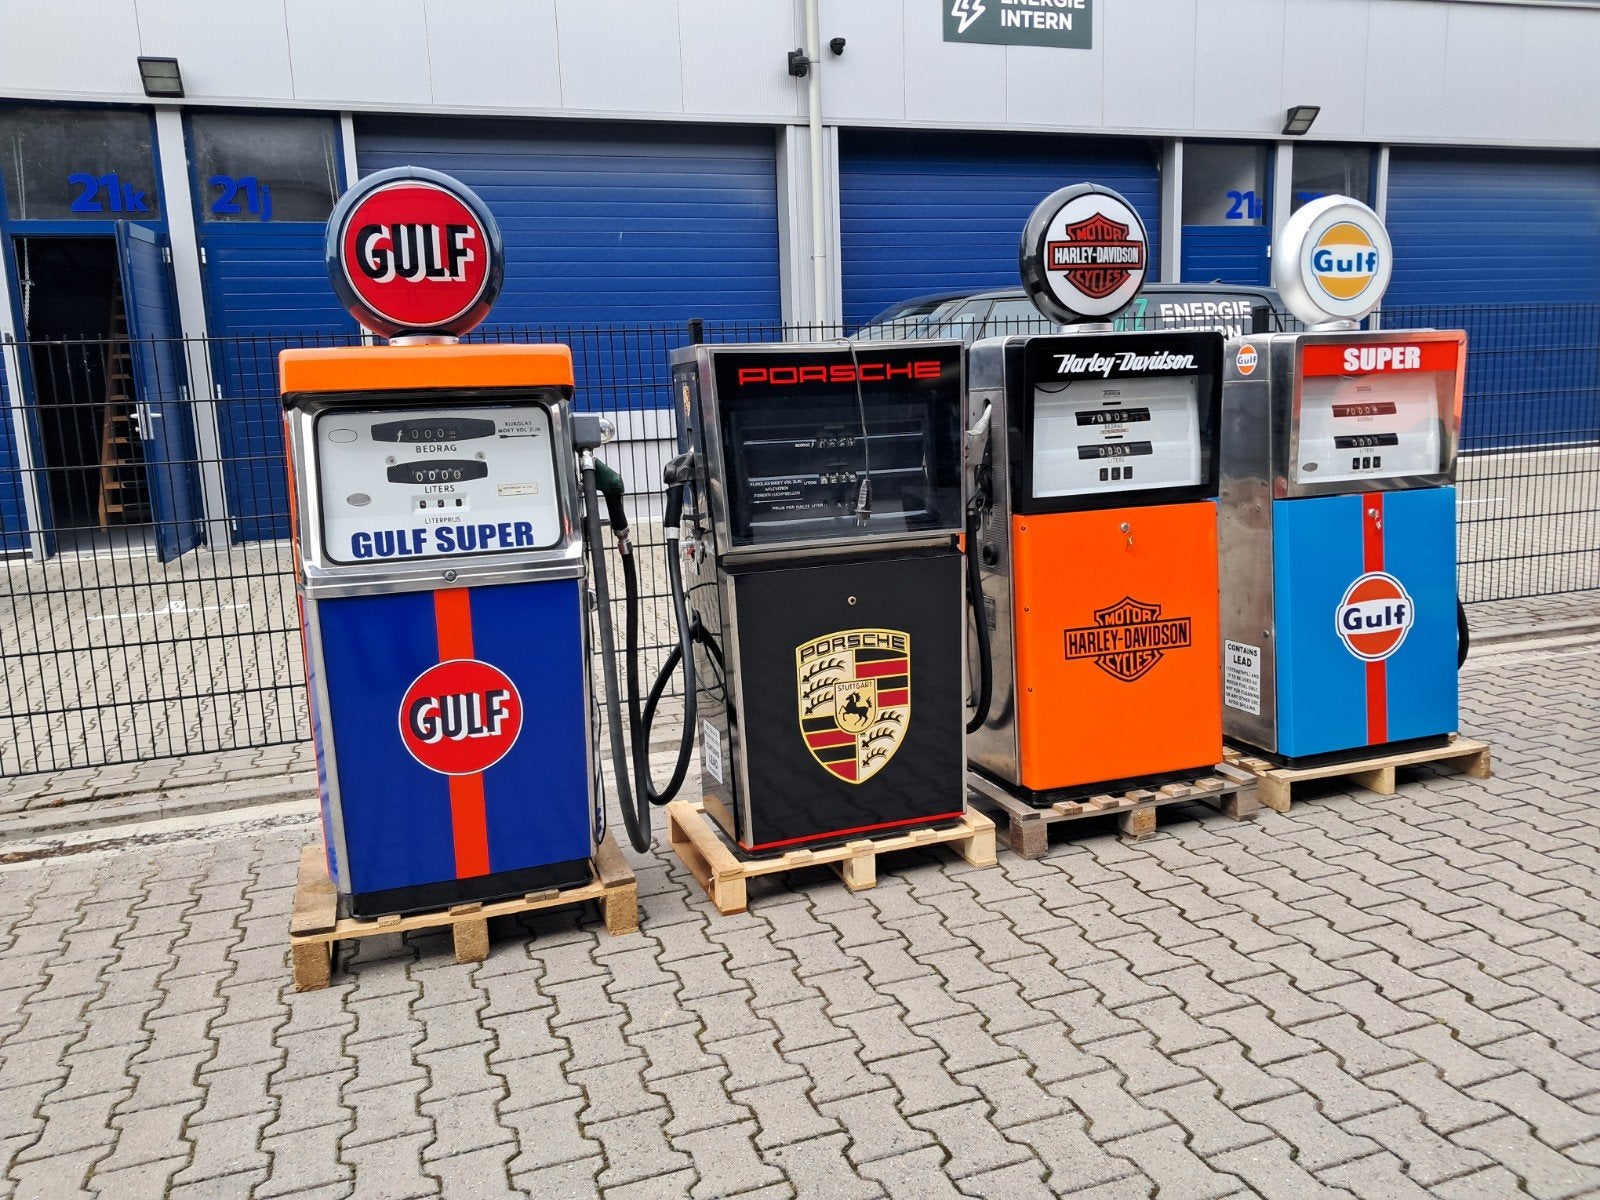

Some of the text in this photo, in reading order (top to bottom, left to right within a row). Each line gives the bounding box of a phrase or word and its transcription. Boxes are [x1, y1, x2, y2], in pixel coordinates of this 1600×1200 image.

[1001, 9, 1072, 31] INTERN
[67, 172, 149, 213] 21k
[208, 175, 273, 221] 21j
[1076, 220, 1122, 241] MOTOR
[355, 223, 476, 284] GULF
[1054, 246, 1139, 265] HARLEY-DAVIDSON
[1313, 249, 1377, 273] Gulf
[1076, 269, 1121, 292] CYCLES
[1160, 301, 1253, 322] ENERGIE
[1053, 351, 1199, 378] Harley-Davidson
[1237, 355, 1257, 365] Gulf
[1343, 347, 1421, 371] SUPER
[738, 361, 942, 386] PORSCHE
[415, 444, 457, 453] BEDRAG
[424, 484, 456, 494] LITERS
[424, 516, 461, 525] LITERPRIJS
[351, 521, 535, 559] GULF SUPER
[1104, 606, 1152, 626] MOTOR
[1343, 604, 1406, 631] Gulf
[801, 633, 906, 664] PORSCHE
[1068, 621, 1188, 655] HARLEY-DAVIDSON
[1227, 643, 1257, 656] CONTAINS
[1105, 650, 1153, 676] CYCLES
[1233, 654, 1251, 667] LEAD
[837, 681, 873, 692] STUTTGART
[409, 689, 511, 744] GULF
